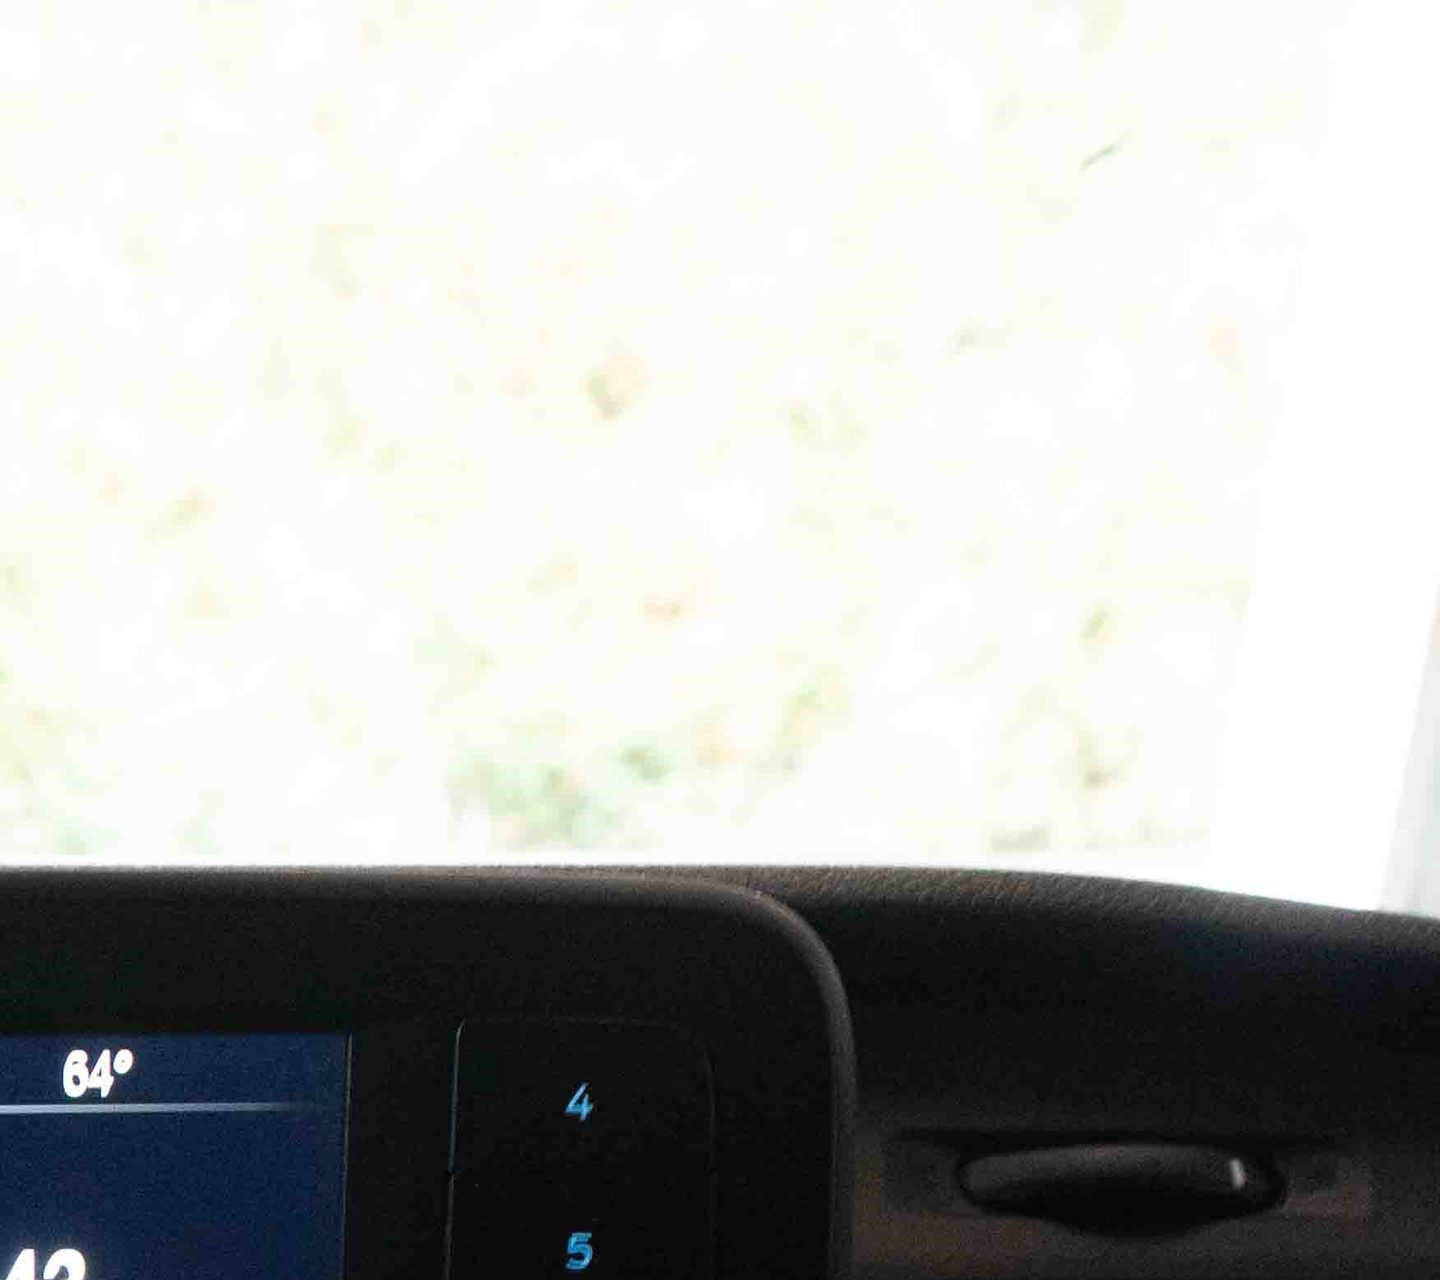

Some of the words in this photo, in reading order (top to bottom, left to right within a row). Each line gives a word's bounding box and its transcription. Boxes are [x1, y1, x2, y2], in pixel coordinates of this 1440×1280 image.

[62, 1048, 134, 1099] 64°
[562, 1081, 595, 1122] 4
[564, 1230, 595, 1272] 5
